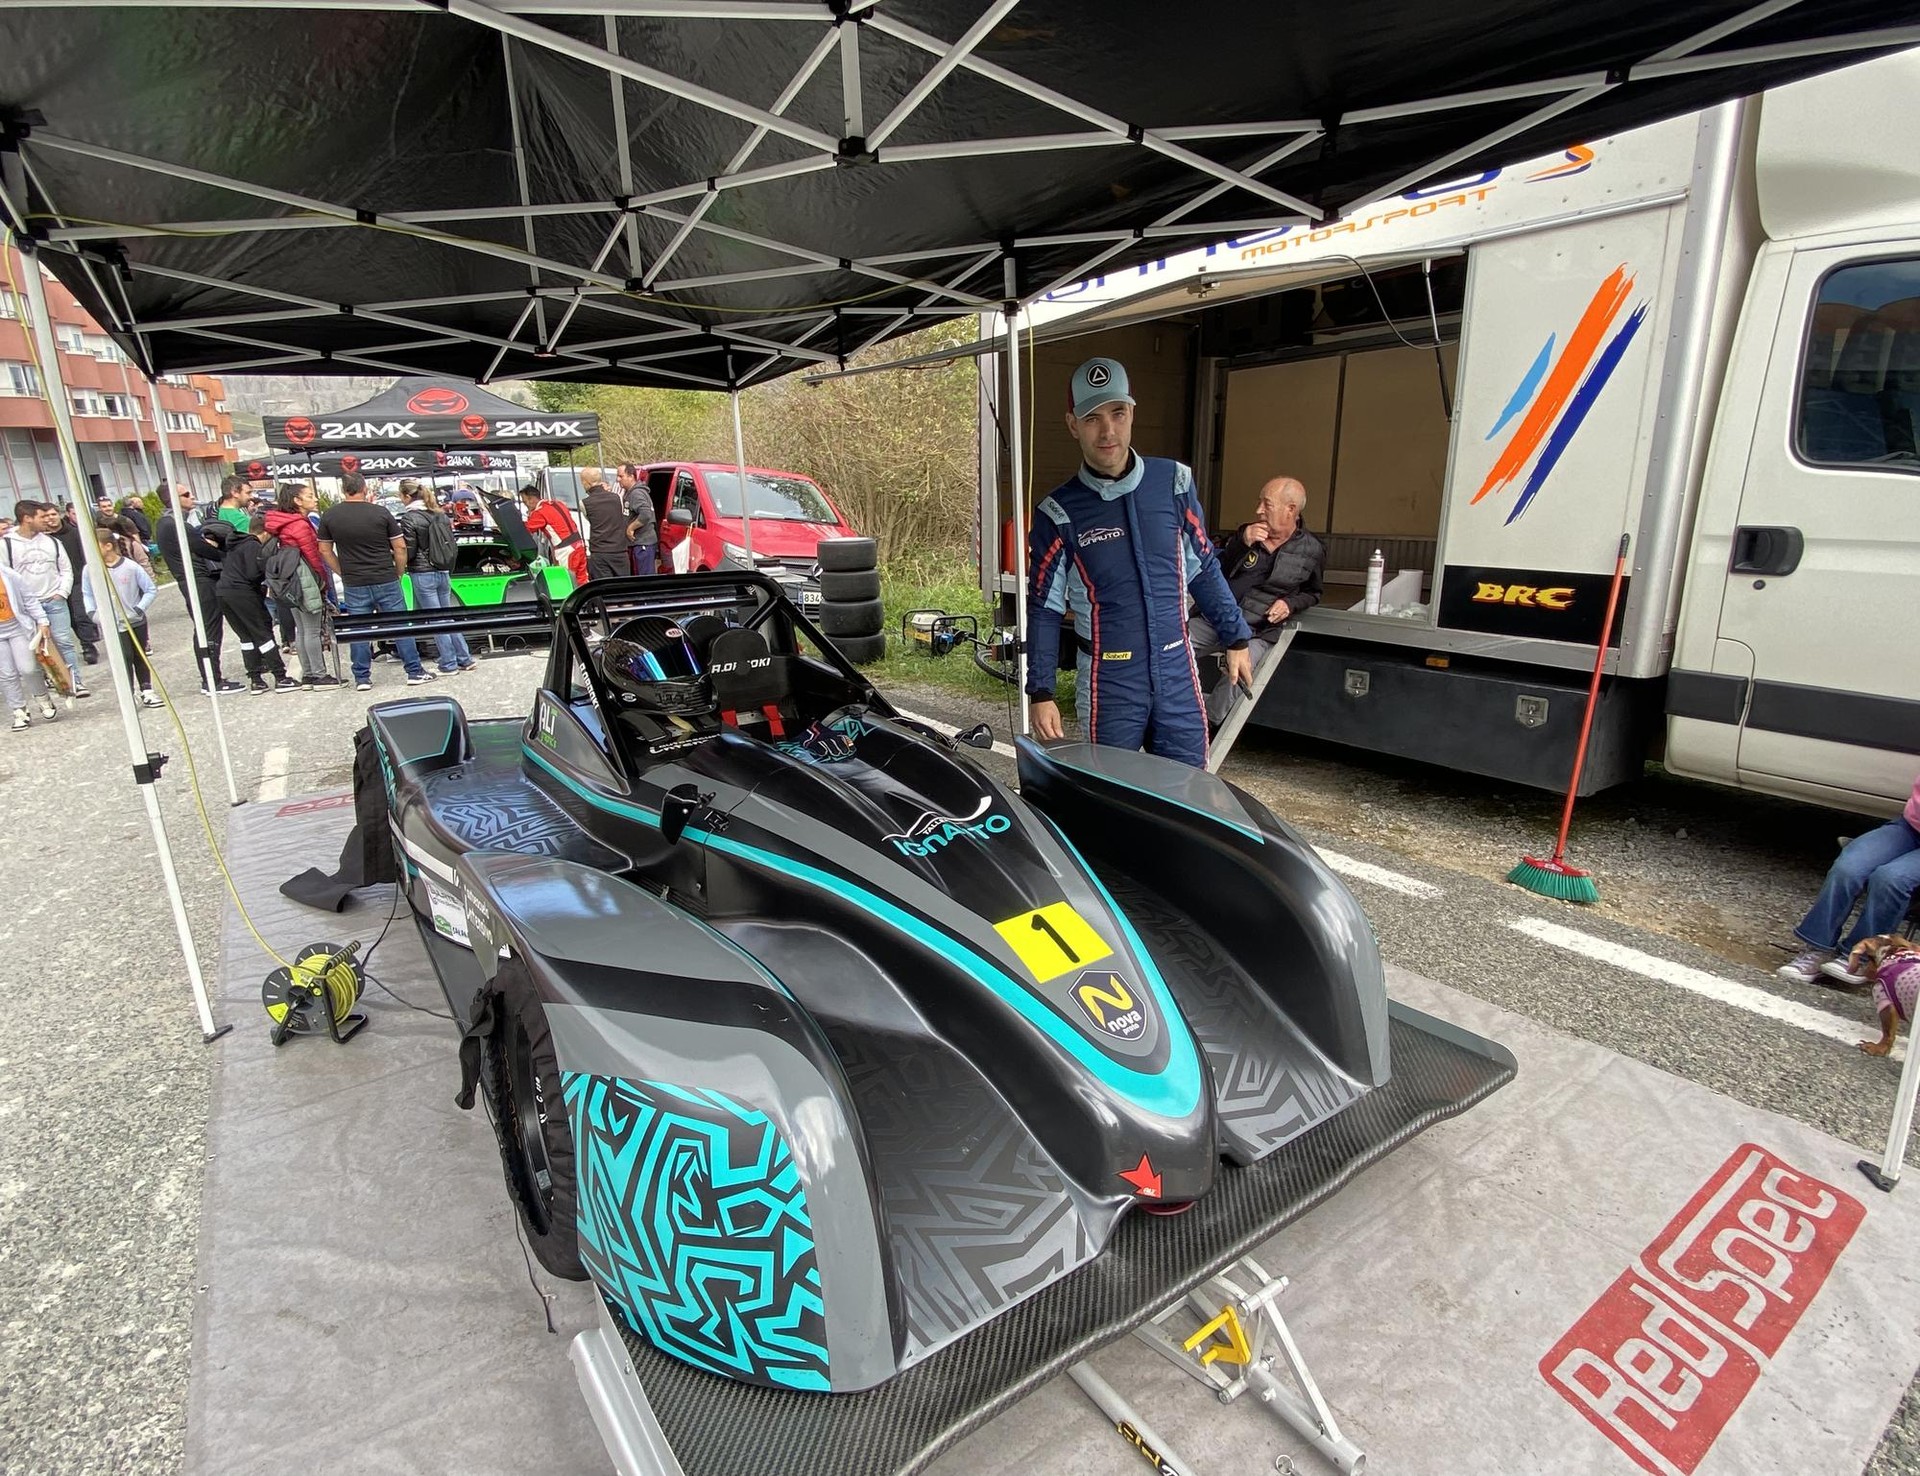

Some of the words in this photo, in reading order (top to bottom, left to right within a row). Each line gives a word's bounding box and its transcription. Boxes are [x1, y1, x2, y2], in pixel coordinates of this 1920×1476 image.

[1241, 186, 1497, 261] MOTORSPORT
[320, 422, 420, 439] 24MX
[495, 421, 584, 437] 24MX
[361, 457, 417, 470] 24MX
[446, 455, 475, 467] 24MX
[488, 456, 513, 468] 24MX
[1472, 581, 1577, 611] BRC
[1031, 914, 1081, 964] 1
[1107, 1010, 1143, 1032] nova
